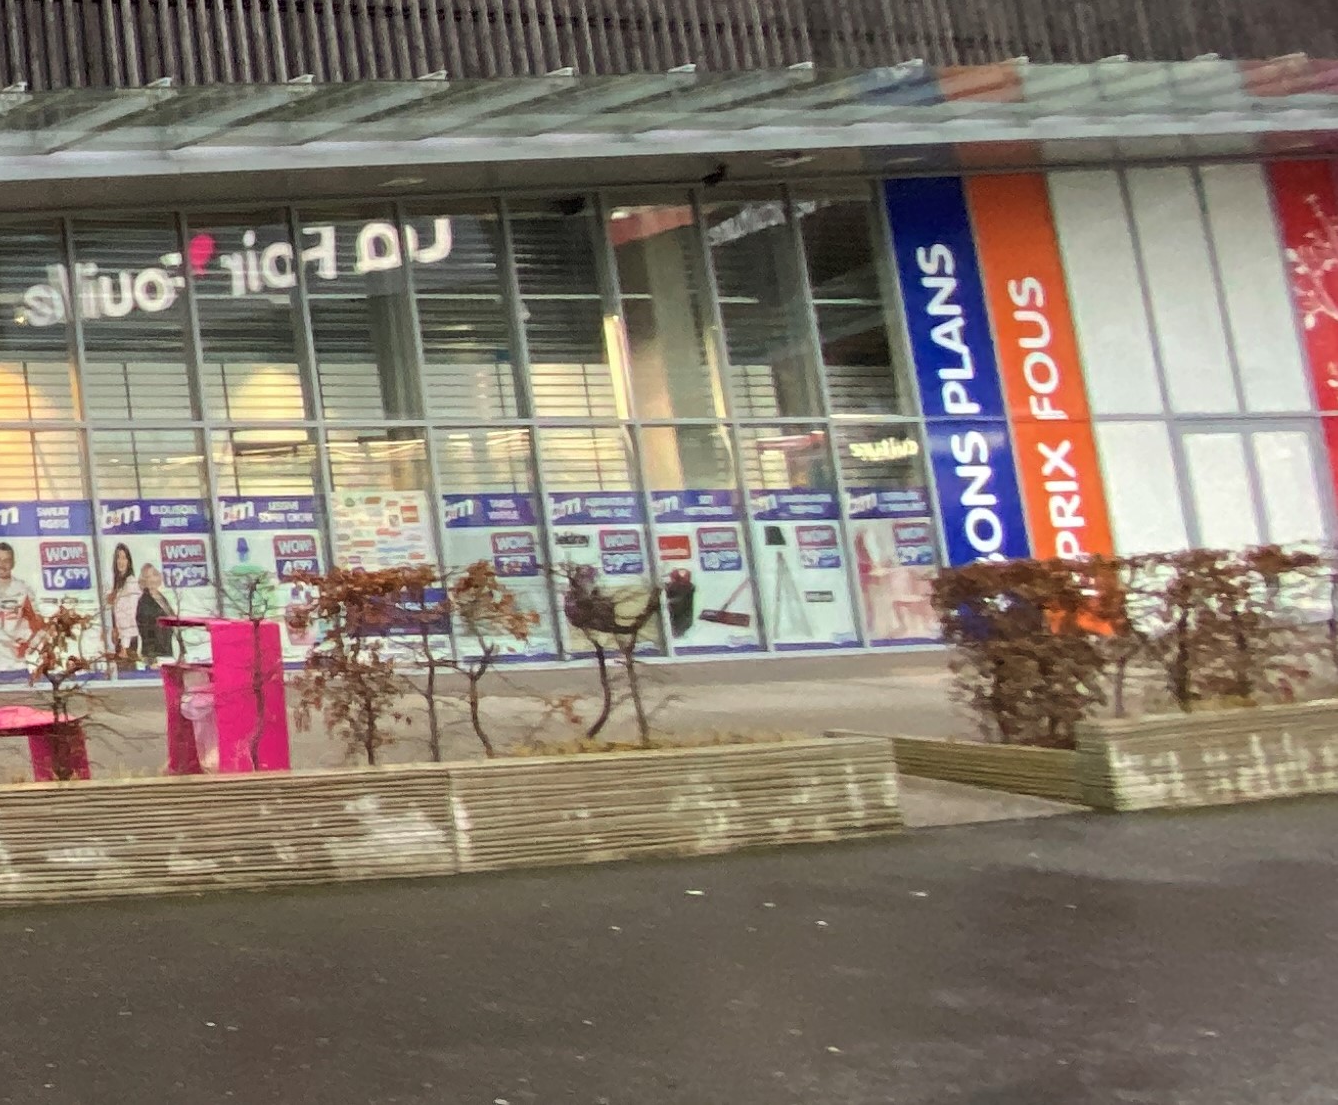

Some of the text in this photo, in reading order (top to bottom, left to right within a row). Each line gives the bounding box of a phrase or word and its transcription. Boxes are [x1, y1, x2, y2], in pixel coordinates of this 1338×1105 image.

[916, 243, 1006, 562] ONS PLANS
[1007, 276, 1091, 563] PRIX FOUS
[45, 547, 83, 561] WOW!
